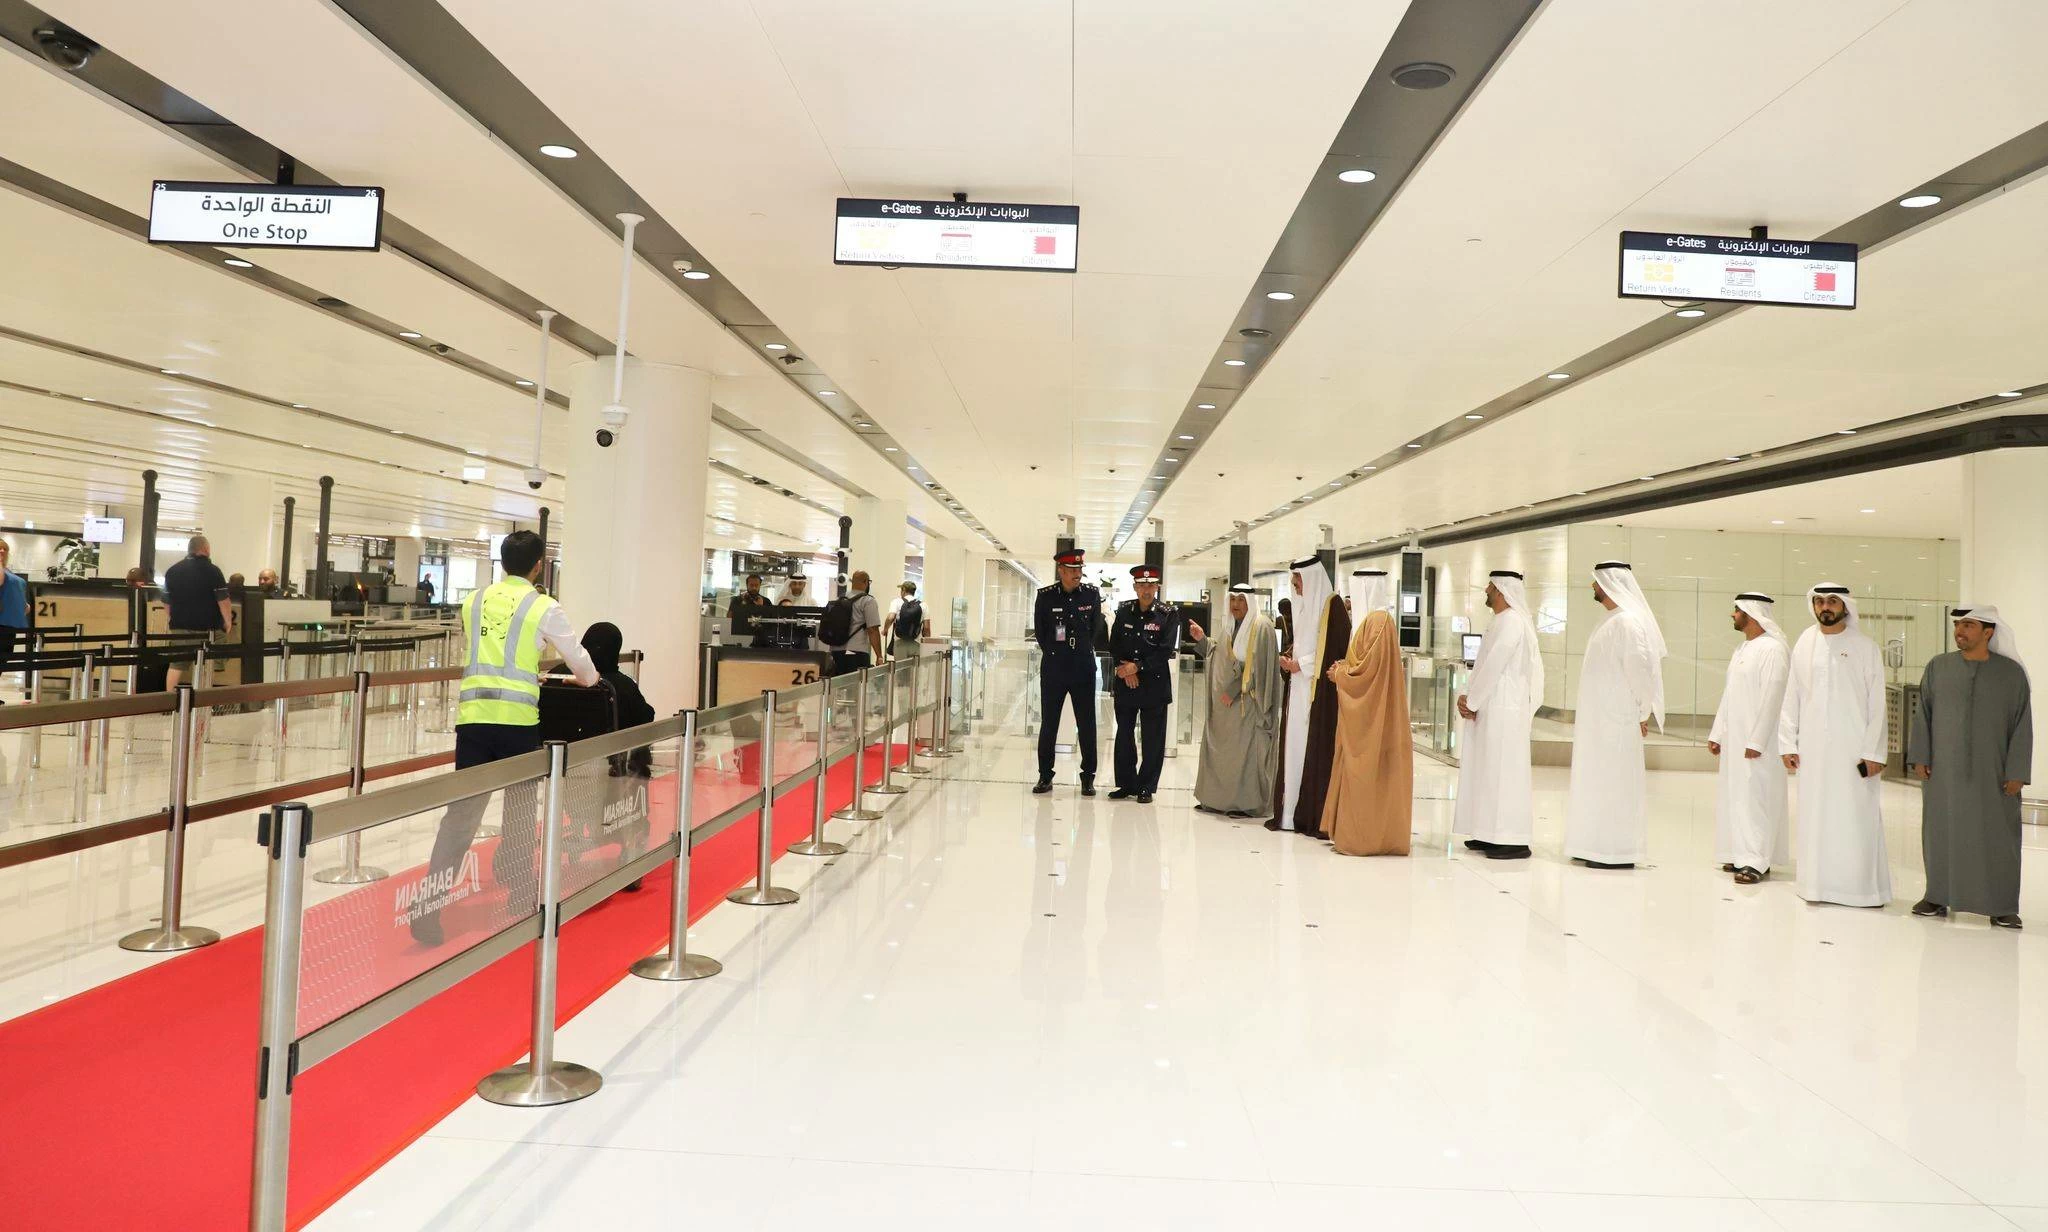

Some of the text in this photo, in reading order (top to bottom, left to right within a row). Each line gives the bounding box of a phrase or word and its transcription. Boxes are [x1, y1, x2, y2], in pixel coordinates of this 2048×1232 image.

[155, 183, 167, 191] 25
[365, 189, 377, 197] 26
[201, 195, 331, 217] النقطة الواحدة
[881, 202, 922, 214] e-Gates
[933, 204, 1029, 219] البوابات الإلكترونية
[222, 222, 307, 243] One Stop
[1666, 236, 1706, 249] e-Gates
[1717, 239, 1810, 256] البوابات الإلكترونية
[1627, 283, 1691, 295] Return Visitors
[1720, 287, 1762, 298] Residents
[1803, 292, 1837, 302] Citizens
[1201, 590, 1210, 602] 5
[37, 601, 57, 617] 21
[791, 669, 816, 685] 26
